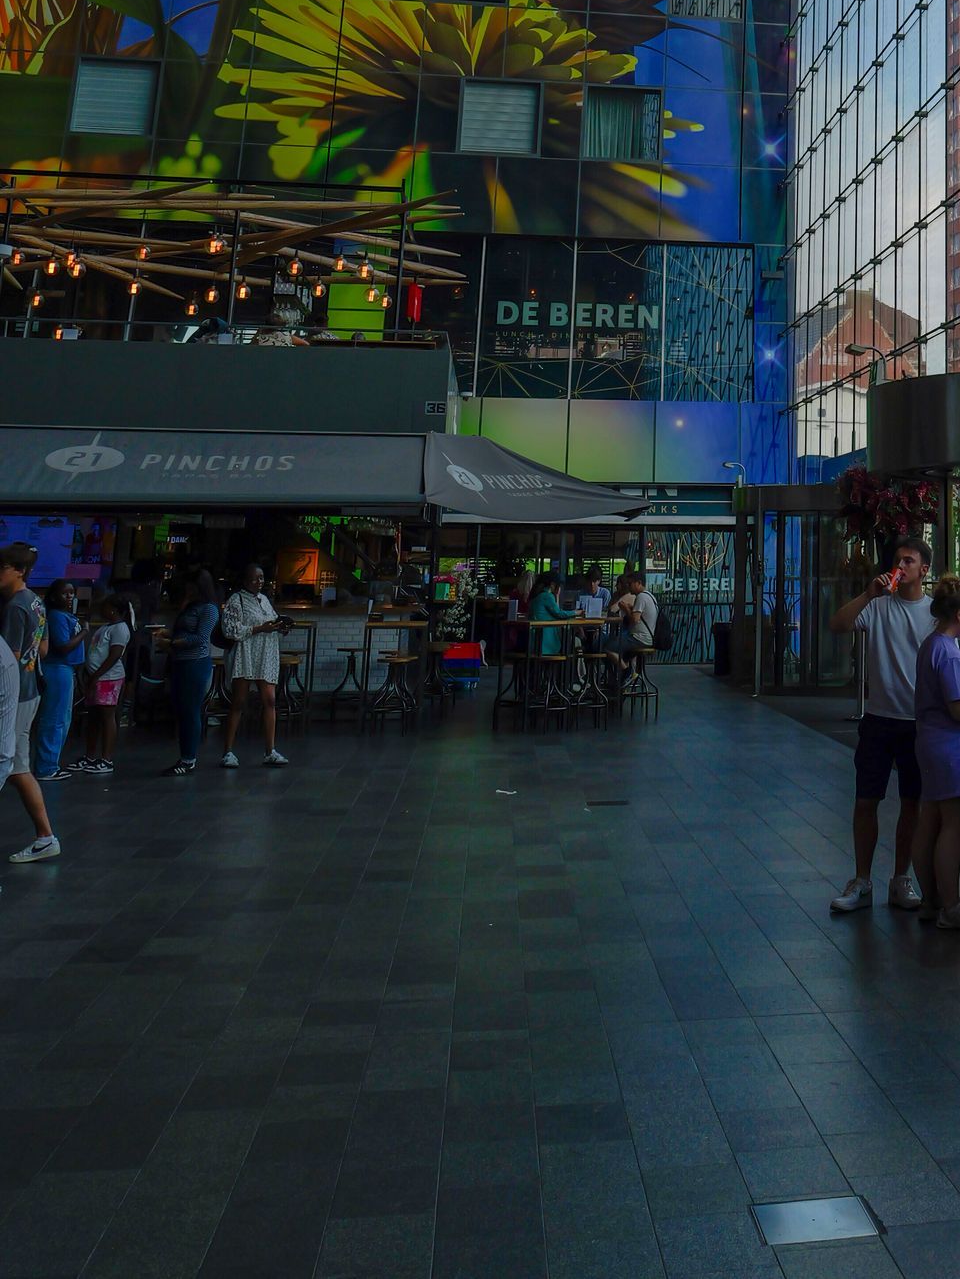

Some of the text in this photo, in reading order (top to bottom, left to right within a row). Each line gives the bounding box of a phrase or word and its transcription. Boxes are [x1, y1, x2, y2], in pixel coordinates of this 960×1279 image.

[496, 301, 659, 329] DE BEREN
[495, 331, 534, 339] LUNCH
[426, 402, 446, 414] 36
[65, 452, 296, 471] 21 PINCHOS
[482, 473, 553, 490] PINCHOS
[664, 577, 684, 591] DE
